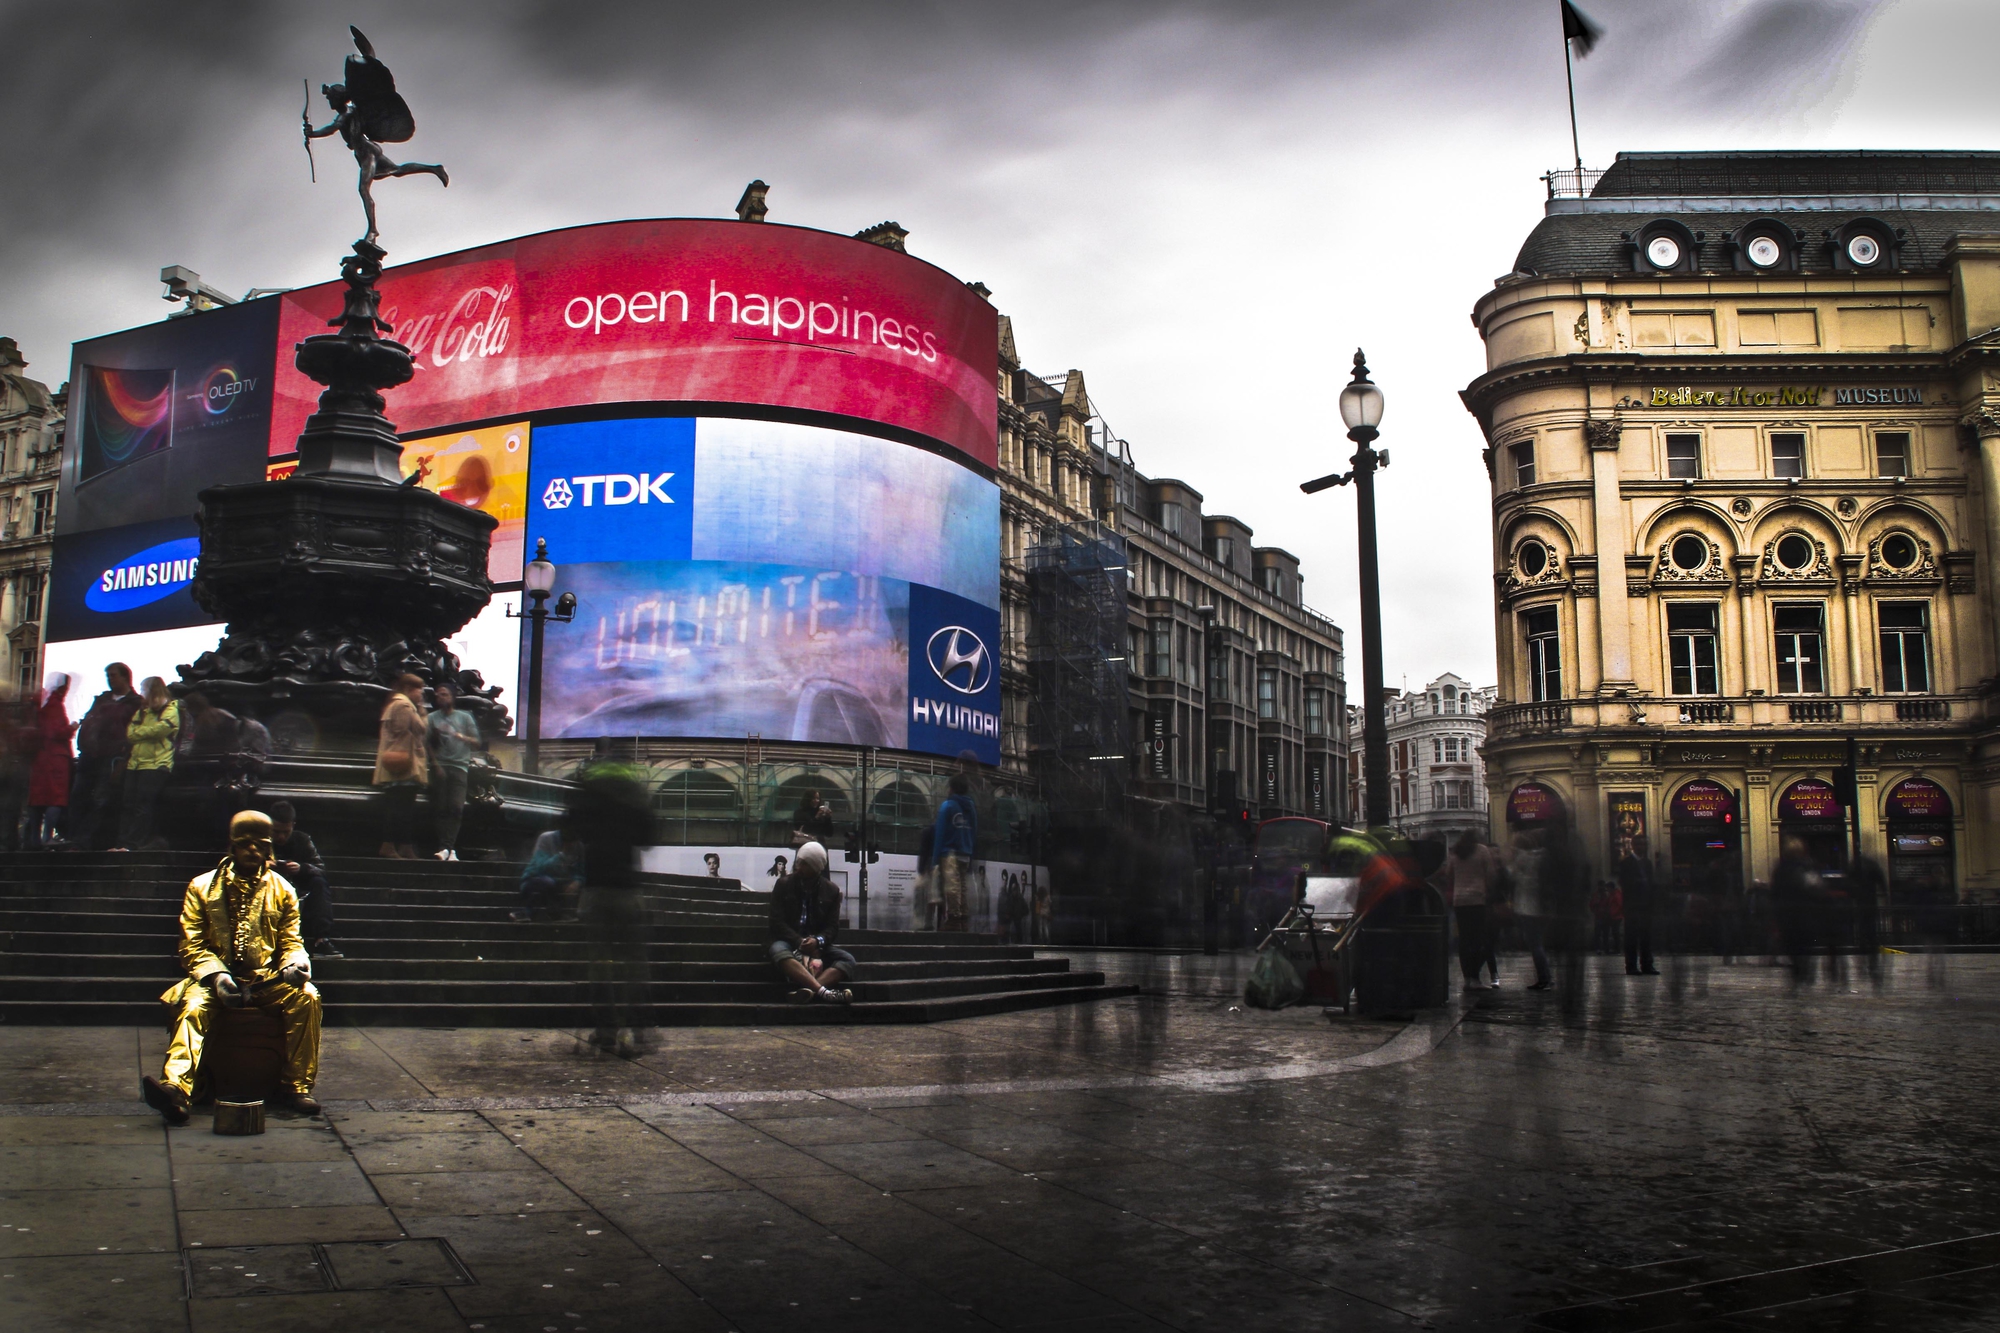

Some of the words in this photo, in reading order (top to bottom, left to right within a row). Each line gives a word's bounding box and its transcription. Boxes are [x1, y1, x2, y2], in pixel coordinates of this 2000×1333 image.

[564, 290, 689, 335] open
[708, 280, 938, 363] happiness
[1650, 386, 1725, 406] Believe
[1730, 386, 1748, 406] It
[1753, 391, 1775, 406] or
[1779, 385, 1824, 406] Not!
[1835, 387, 1922, 404] MUSEUM
[572, 472, 675, 507] TDK
[913, 696, 999, 739] HYUNDAI
[1681, 792, 1713, 801] Believe
[1789, 791, 1821, 800] Believe
